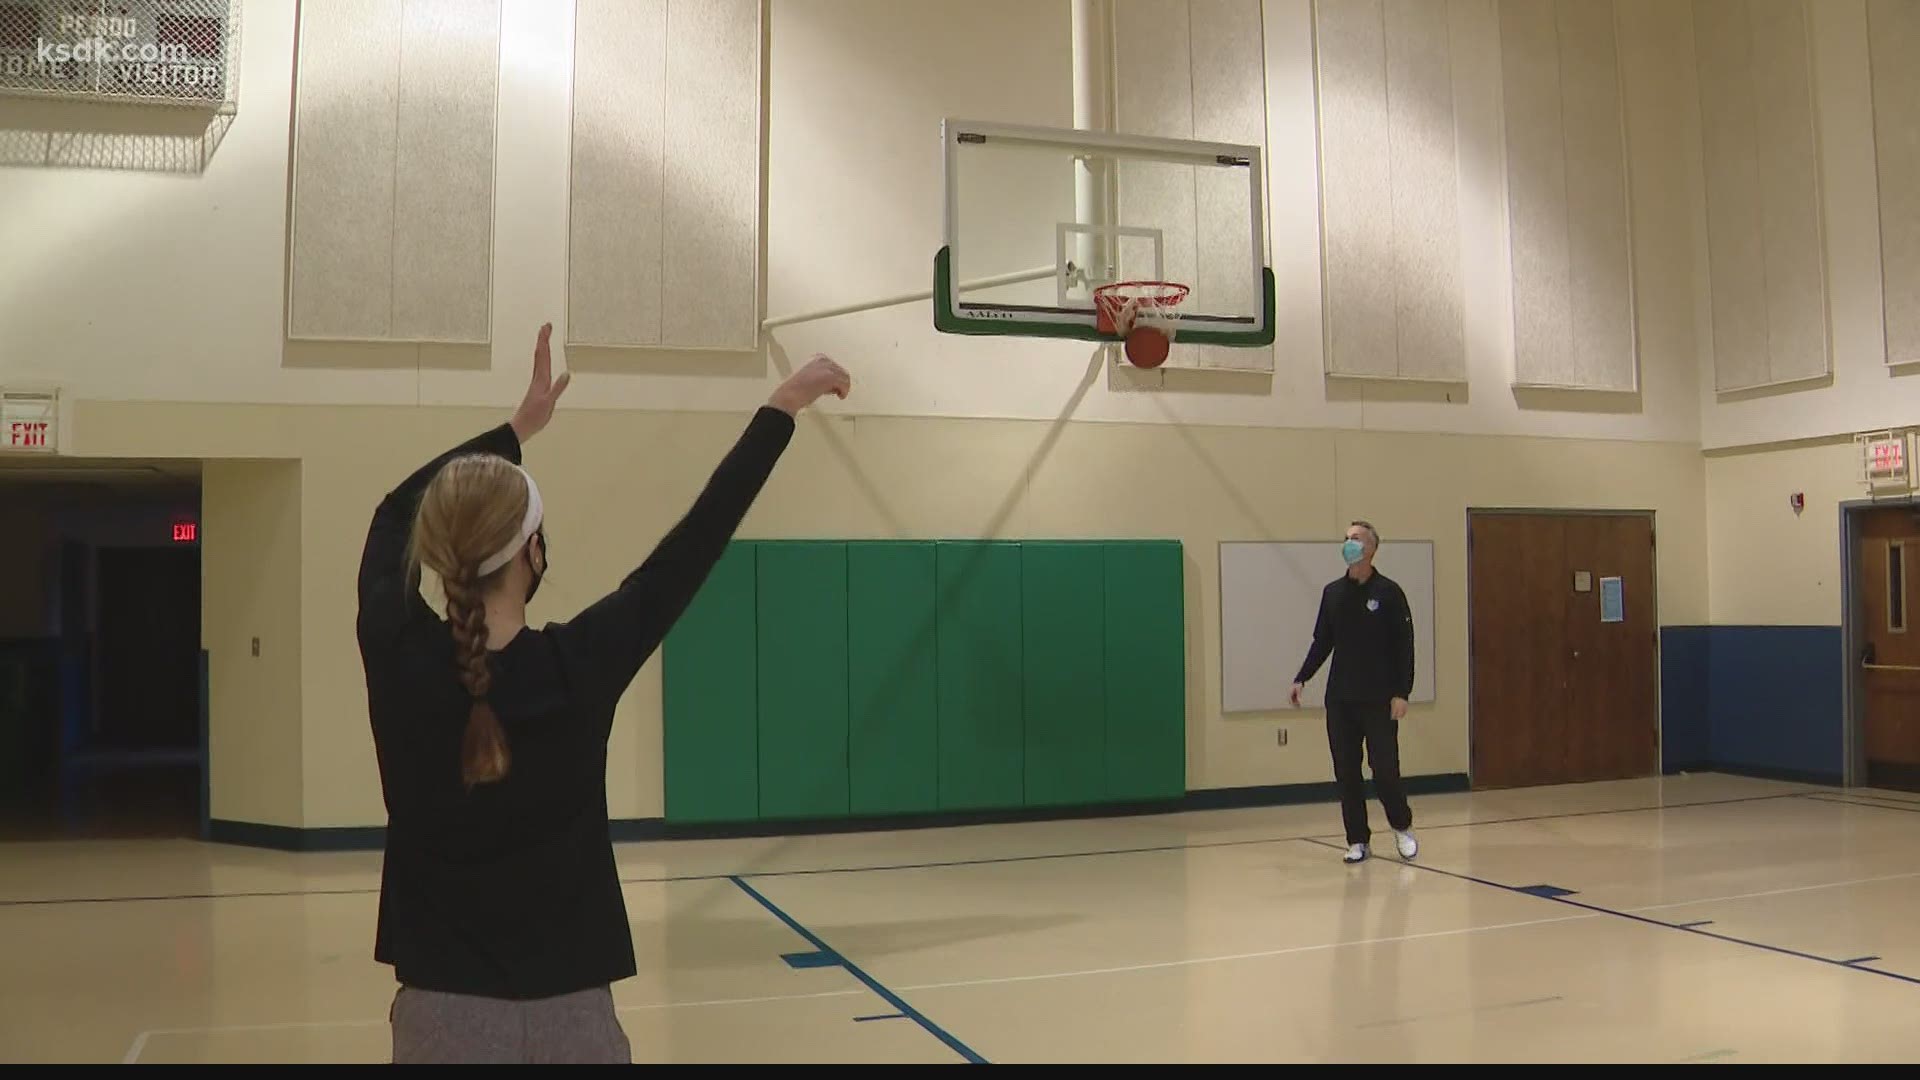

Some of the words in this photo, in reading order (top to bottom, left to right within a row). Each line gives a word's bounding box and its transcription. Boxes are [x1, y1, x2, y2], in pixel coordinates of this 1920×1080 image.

[0, 54, 68, 79] OME
[120, 62, 218, 85] VISITOR
[12, 422, 48, 446] EXIT
[1874, 444, 1900, 468] EXT
[173, 523, 196, 540] EXIT
